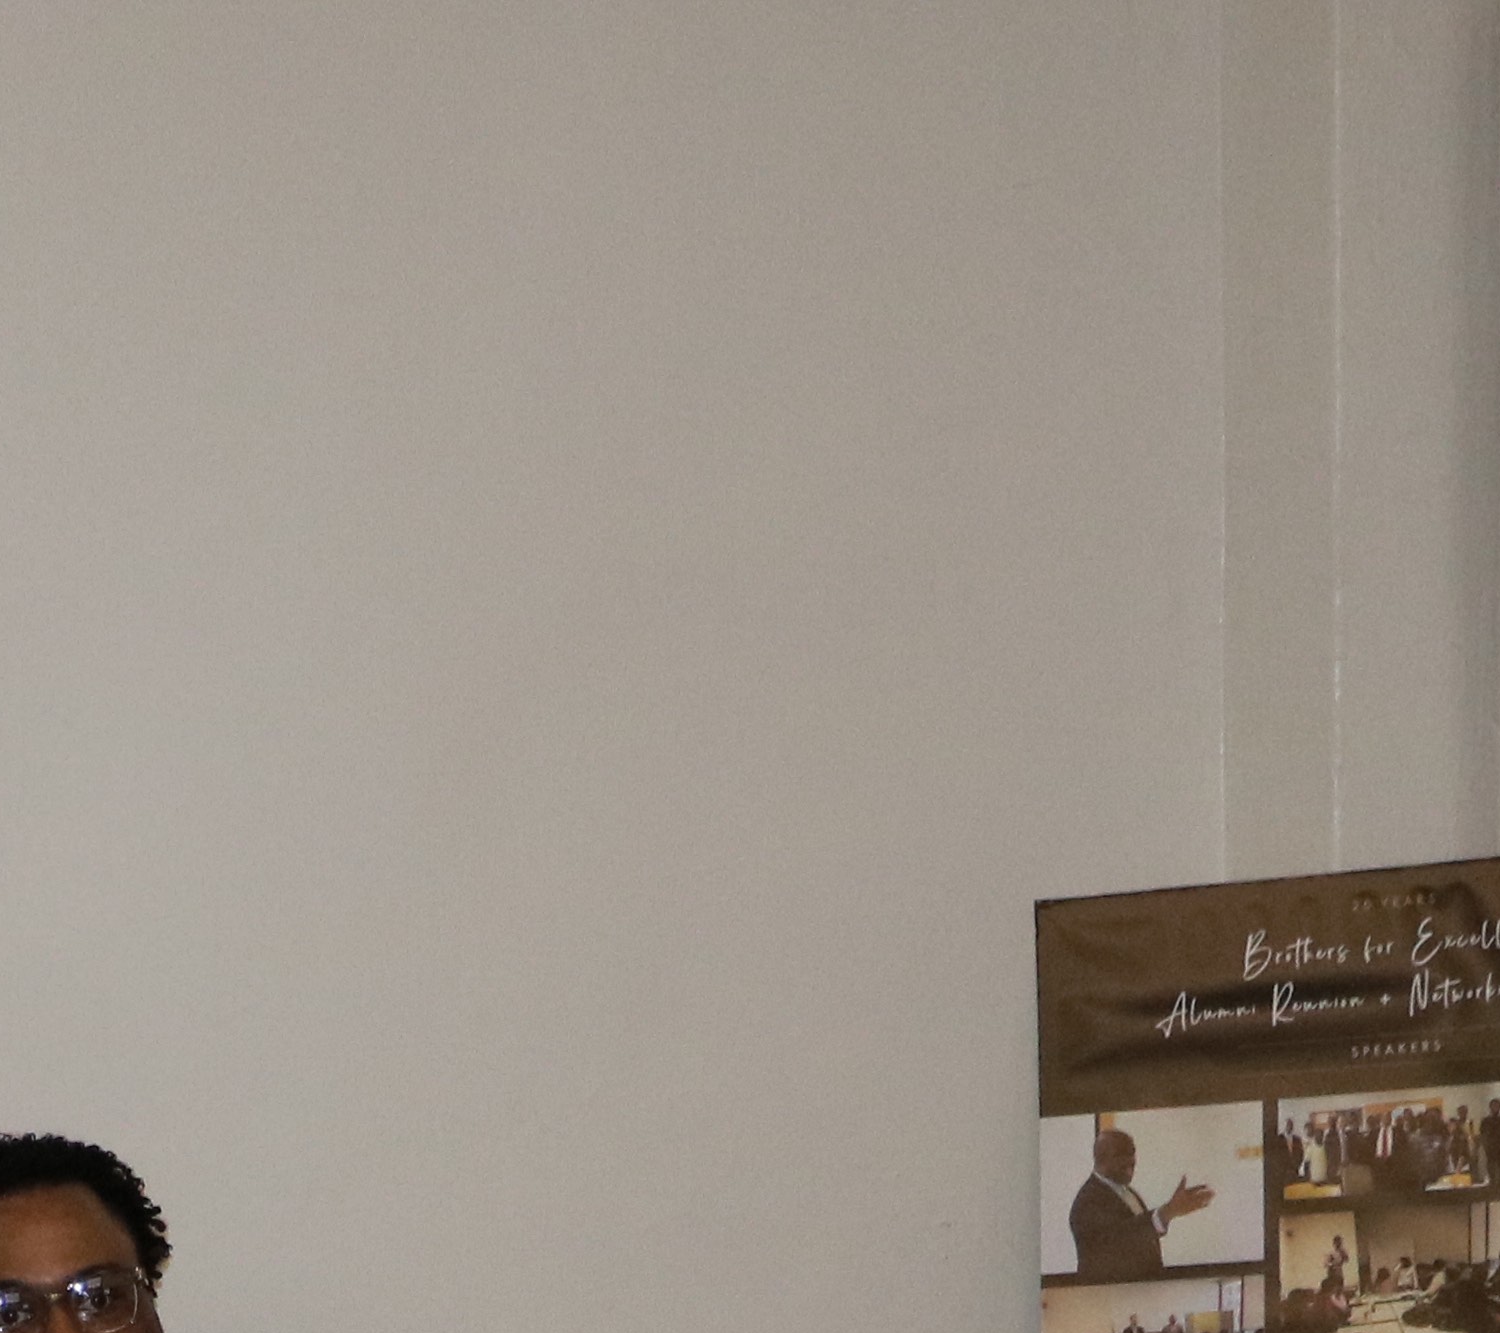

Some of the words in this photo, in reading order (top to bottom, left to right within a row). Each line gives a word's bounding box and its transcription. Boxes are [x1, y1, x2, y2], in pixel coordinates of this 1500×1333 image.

[1242, 929, 1350, 982] Brothers
[1364, 935, 1394, 963] for
[1155, 990, 1256, 1038] Alumni
[1272, 981, 1364, 1027] Reunion
[1351, 1039, 1442, 1058] SPEAKERS
